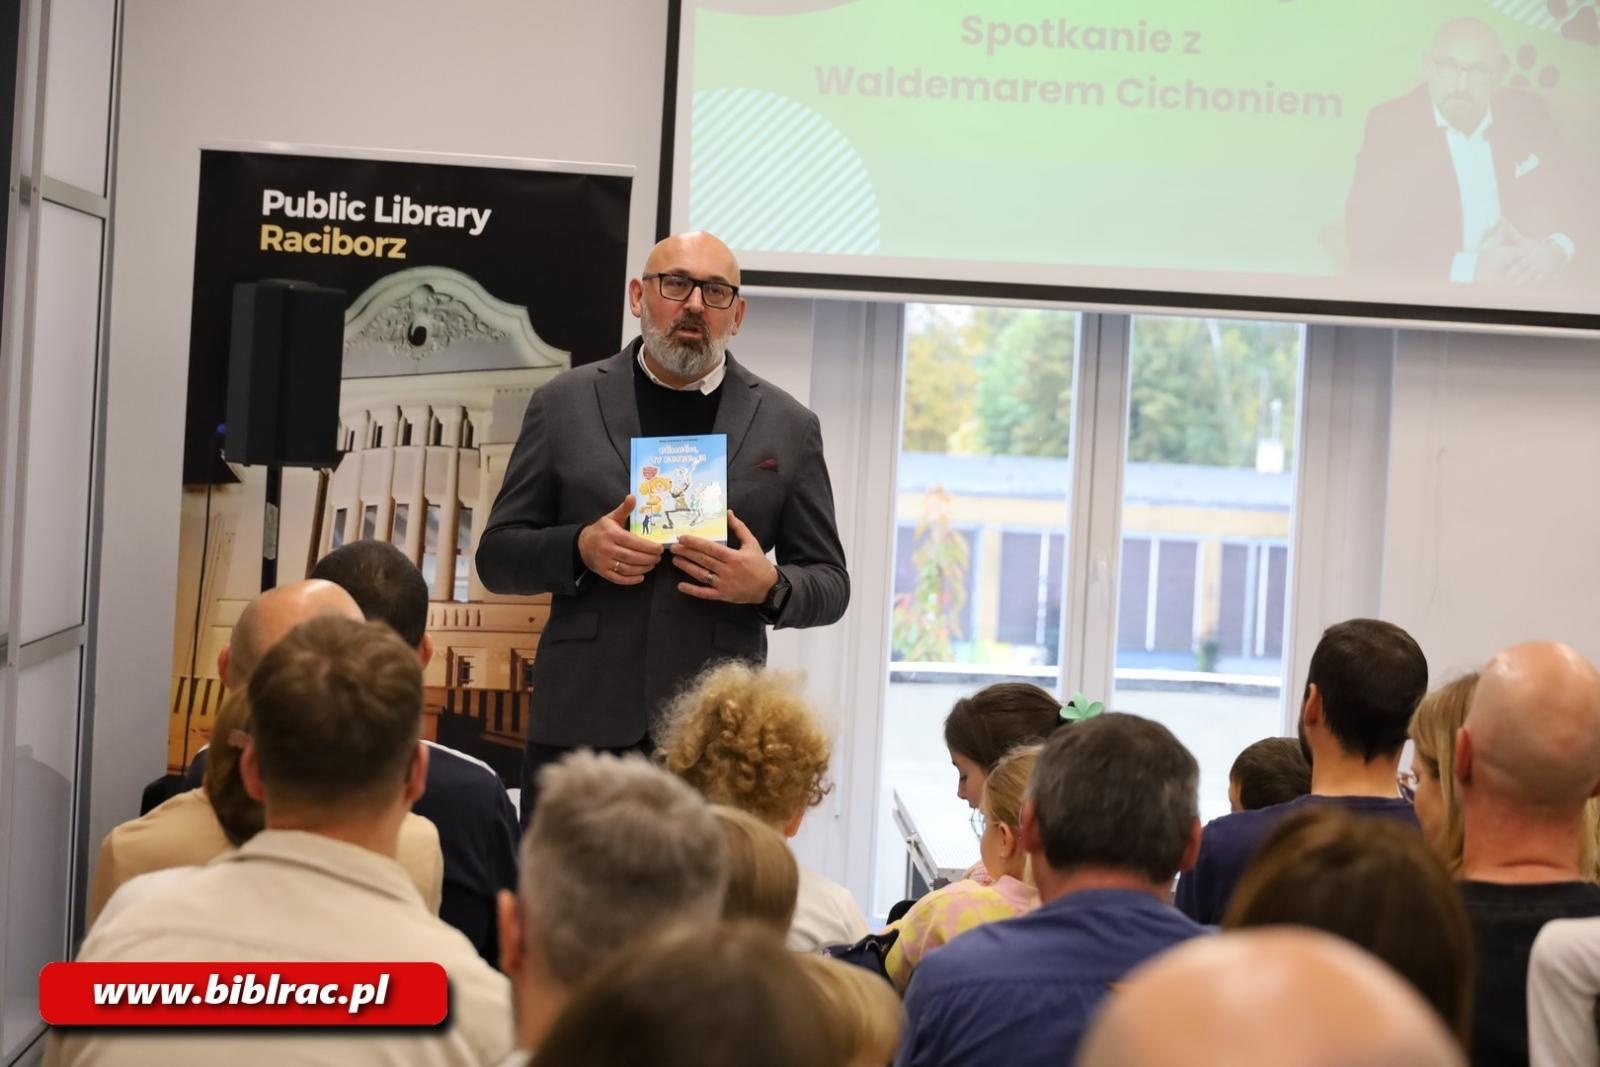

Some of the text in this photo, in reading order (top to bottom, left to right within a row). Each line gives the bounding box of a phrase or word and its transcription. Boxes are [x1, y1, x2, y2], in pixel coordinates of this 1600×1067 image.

[961, 15, 1202, 56] Spotkanie z
[814, 64, 1343, 118] Waldemarem Cichoniem
[262, 189, 492, 236] Public Library
[260, 225, 407, 259] Raciborz
